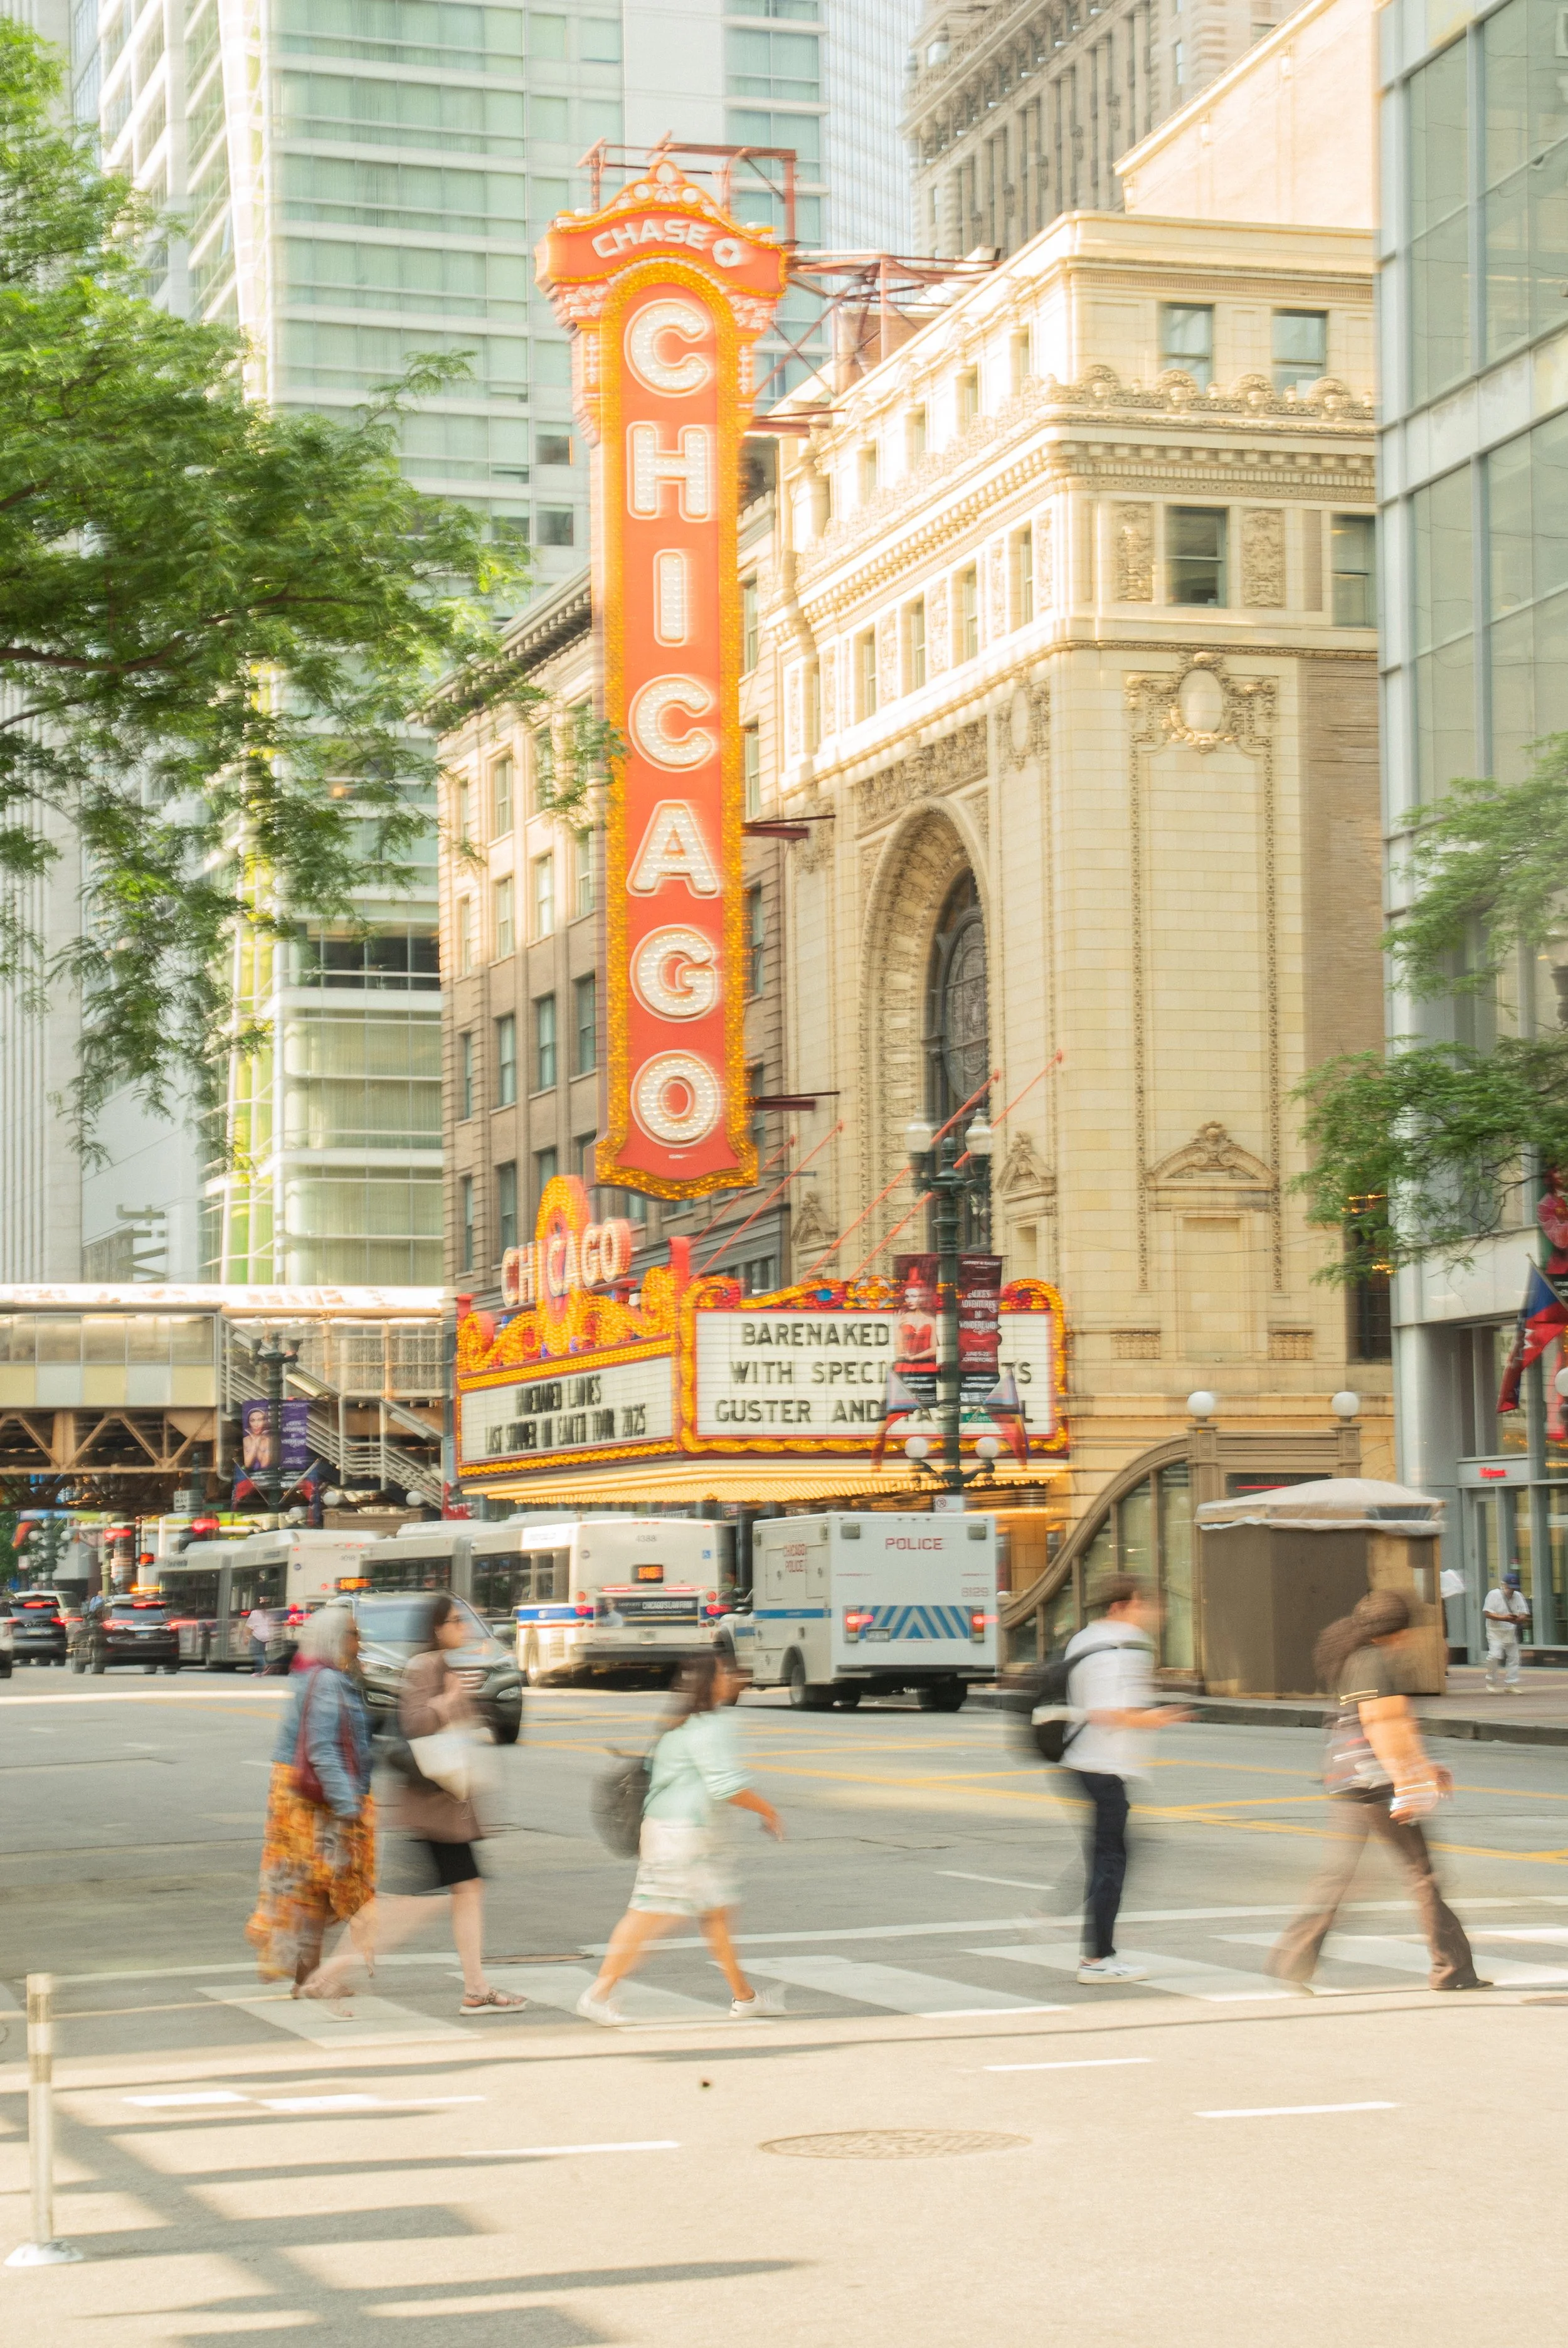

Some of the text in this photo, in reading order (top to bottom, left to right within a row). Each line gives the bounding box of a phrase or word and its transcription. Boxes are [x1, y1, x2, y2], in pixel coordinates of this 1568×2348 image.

[591, 219, 710, 258] CHASE
[624, 298, 720, 1149] CHICAGO
[501, 1216, 630, 1307] CHICAGO
[741, 1322, 889, 1346] BARENAKED
[729, 1361, 887, 1384] WITH SPECI
[714, 1400, 811, 1423] GUSTER
[830, 1400, 888, 1423] AND
[885, 1538, 944, 1550] POLICE
